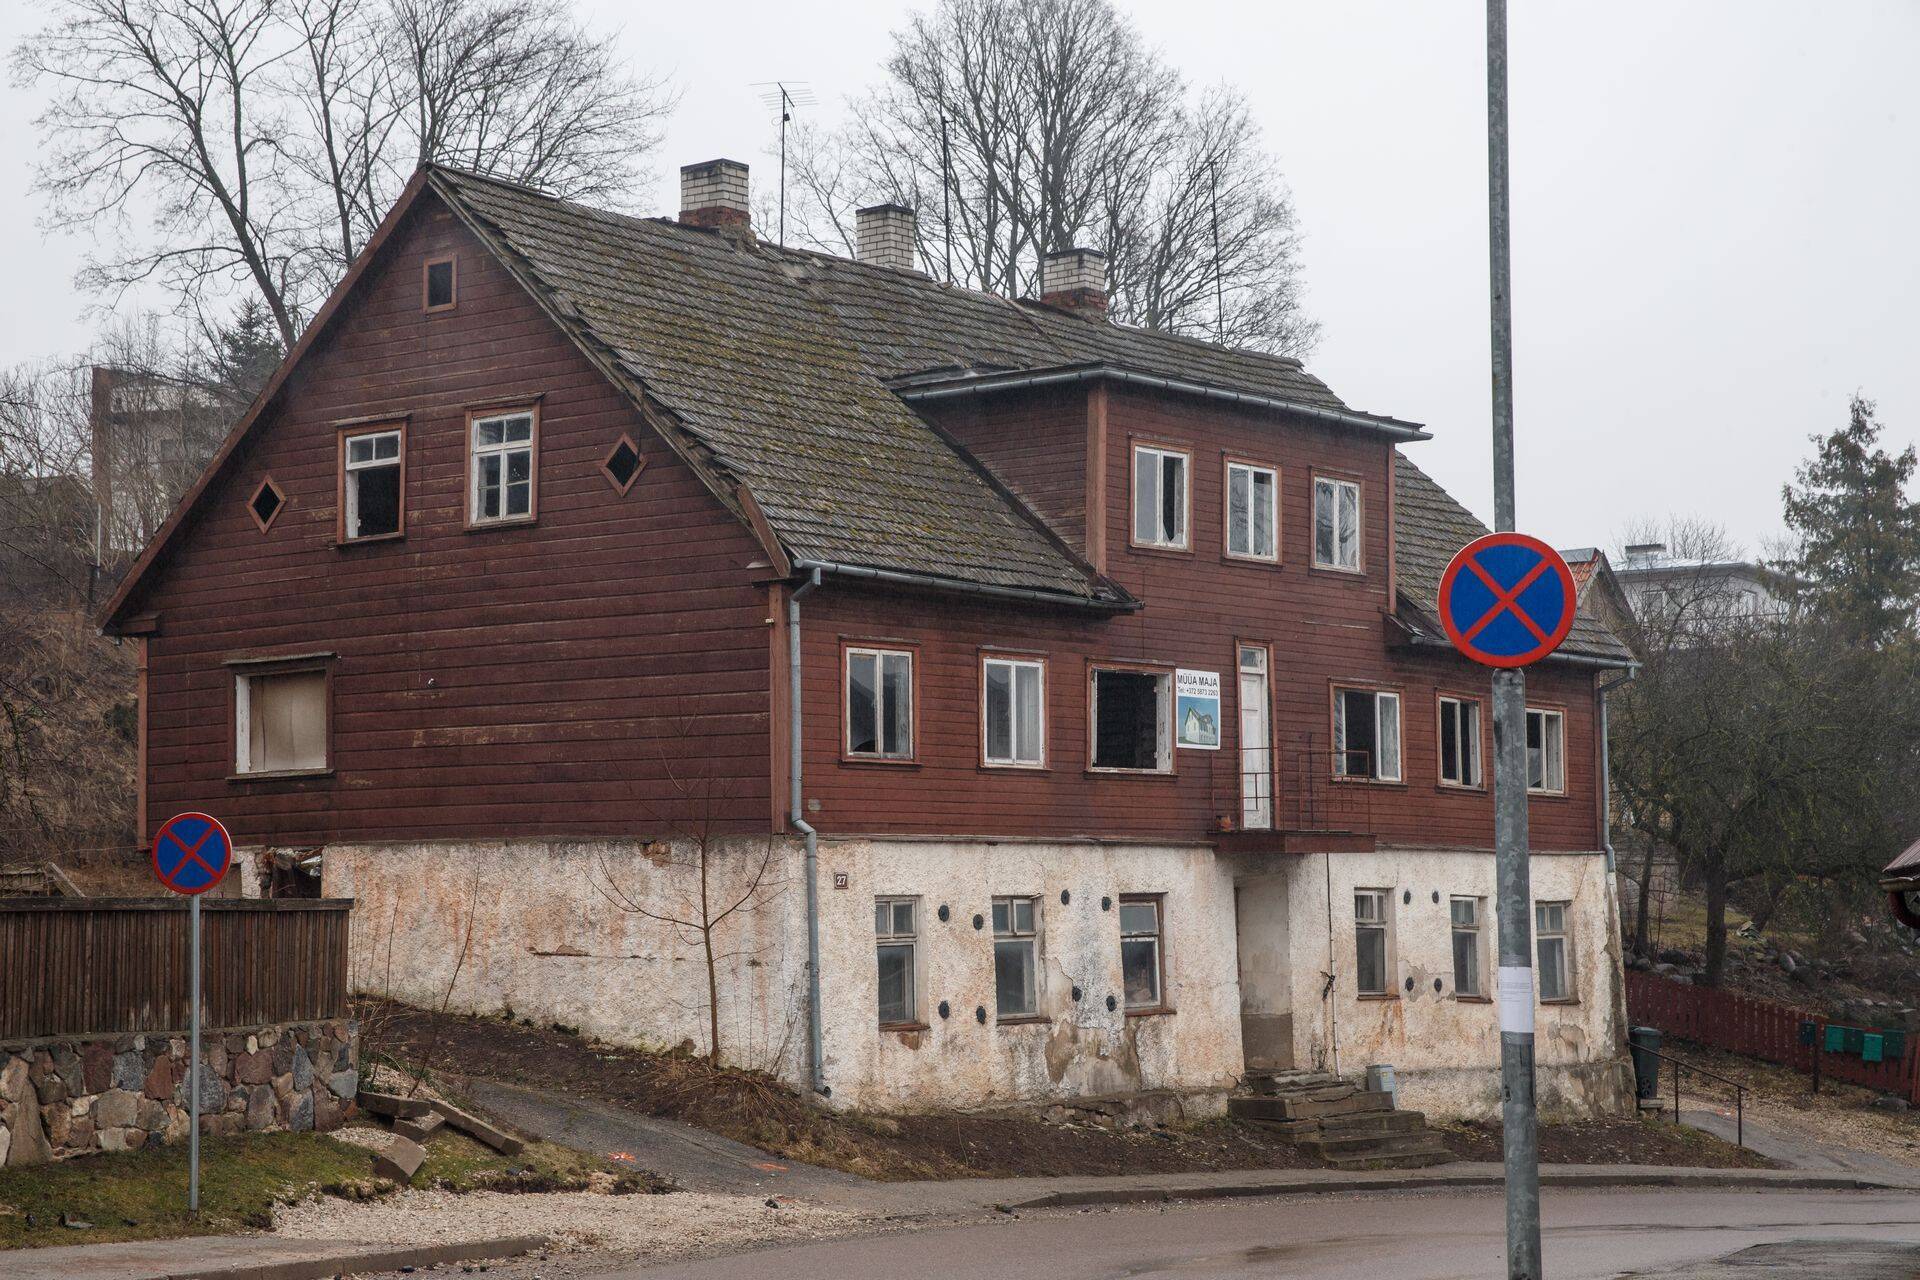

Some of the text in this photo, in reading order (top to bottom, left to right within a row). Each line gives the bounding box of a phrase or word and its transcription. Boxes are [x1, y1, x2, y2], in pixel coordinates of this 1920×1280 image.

[1177, 673, 1218, 687] MÜÜA MAJA
[1186, 687, 1196, 695] +372
[837, 876, 846, 885] 27
